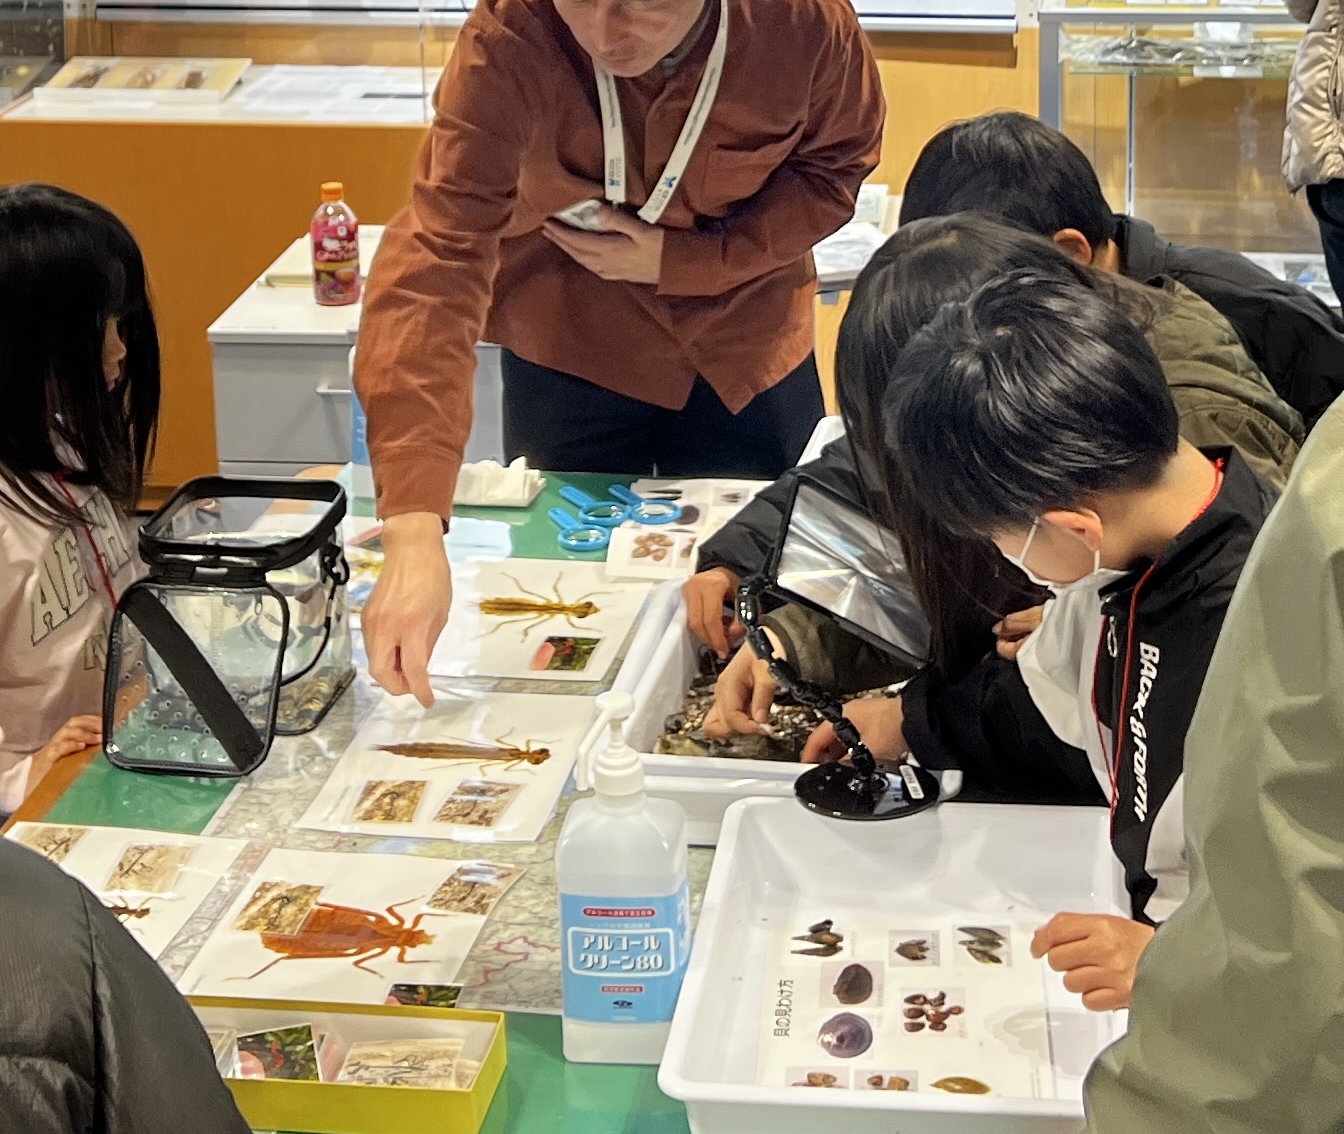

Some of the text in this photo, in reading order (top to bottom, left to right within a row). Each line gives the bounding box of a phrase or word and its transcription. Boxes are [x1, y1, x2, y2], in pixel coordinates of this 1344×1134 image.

[582, 934, 662, 951] アルコール
[579, 953, 664, 971] クリーン80
